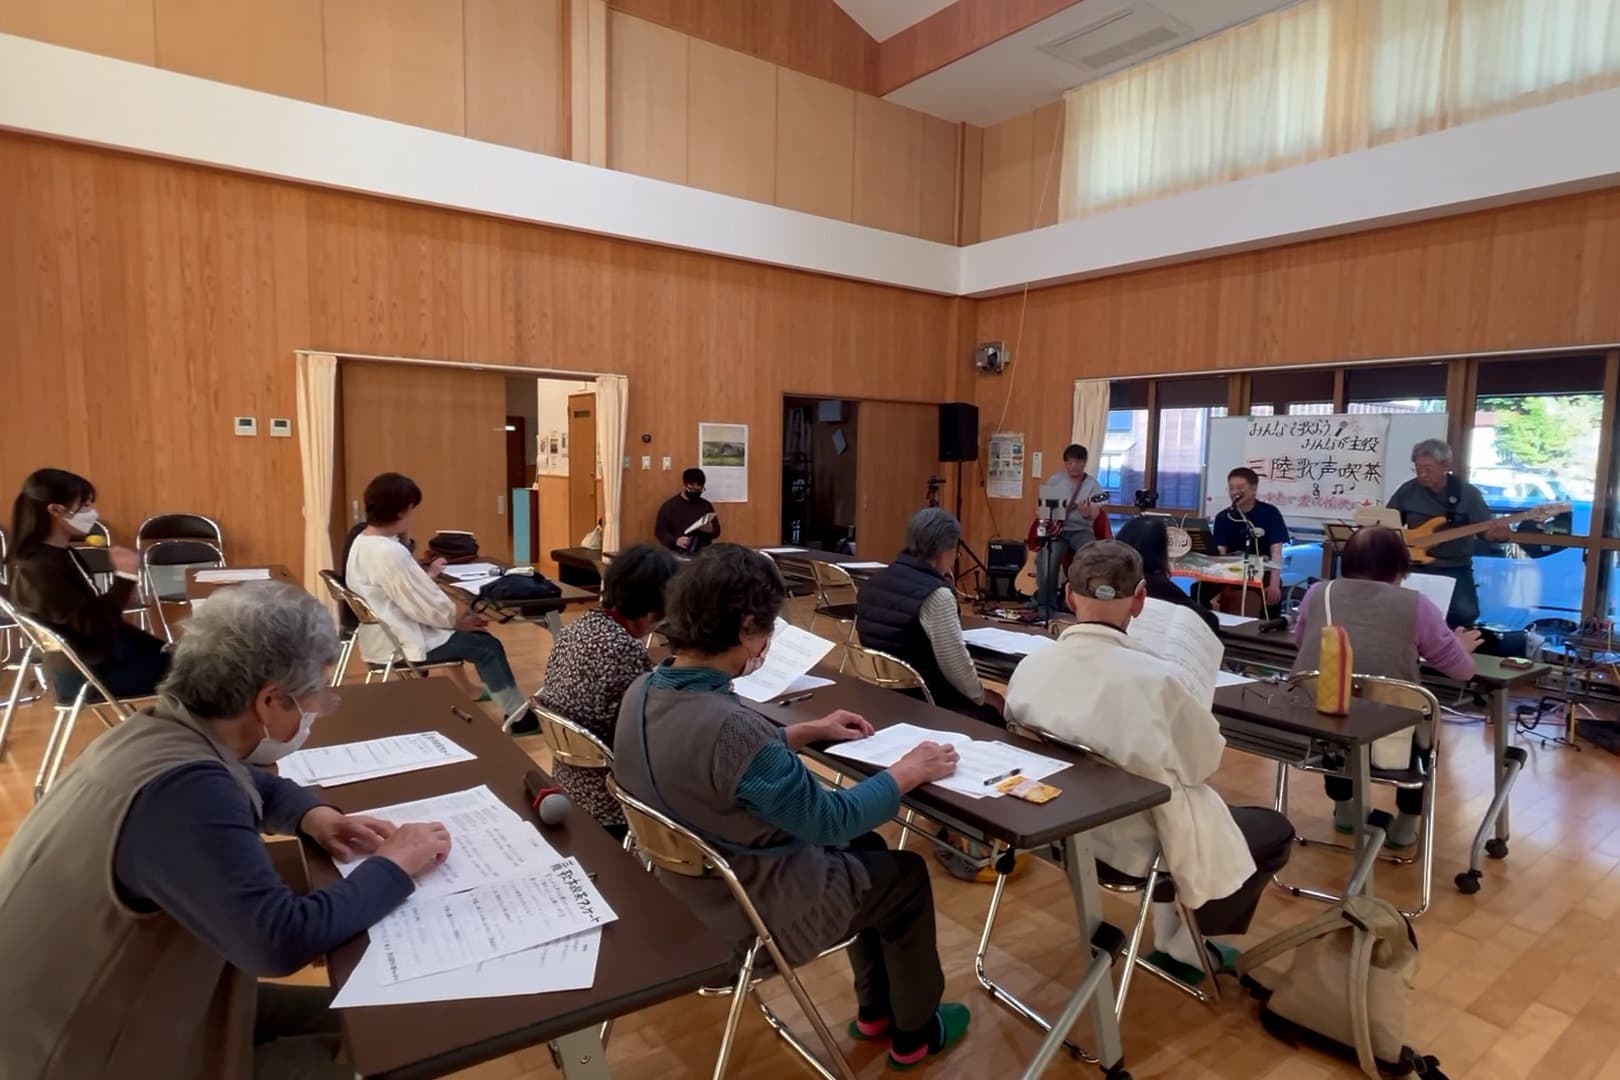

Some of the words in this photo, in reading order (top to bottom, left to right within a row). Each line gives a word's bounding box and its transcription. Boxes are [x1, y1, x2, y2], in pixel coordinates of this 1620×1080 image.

[1249, 418, 1331, 437] みんなで歌おう
[1301, 435, 1380, 453] みんなが主役
[1249, 455, 1382, 484] 三陸歌声喫茶
